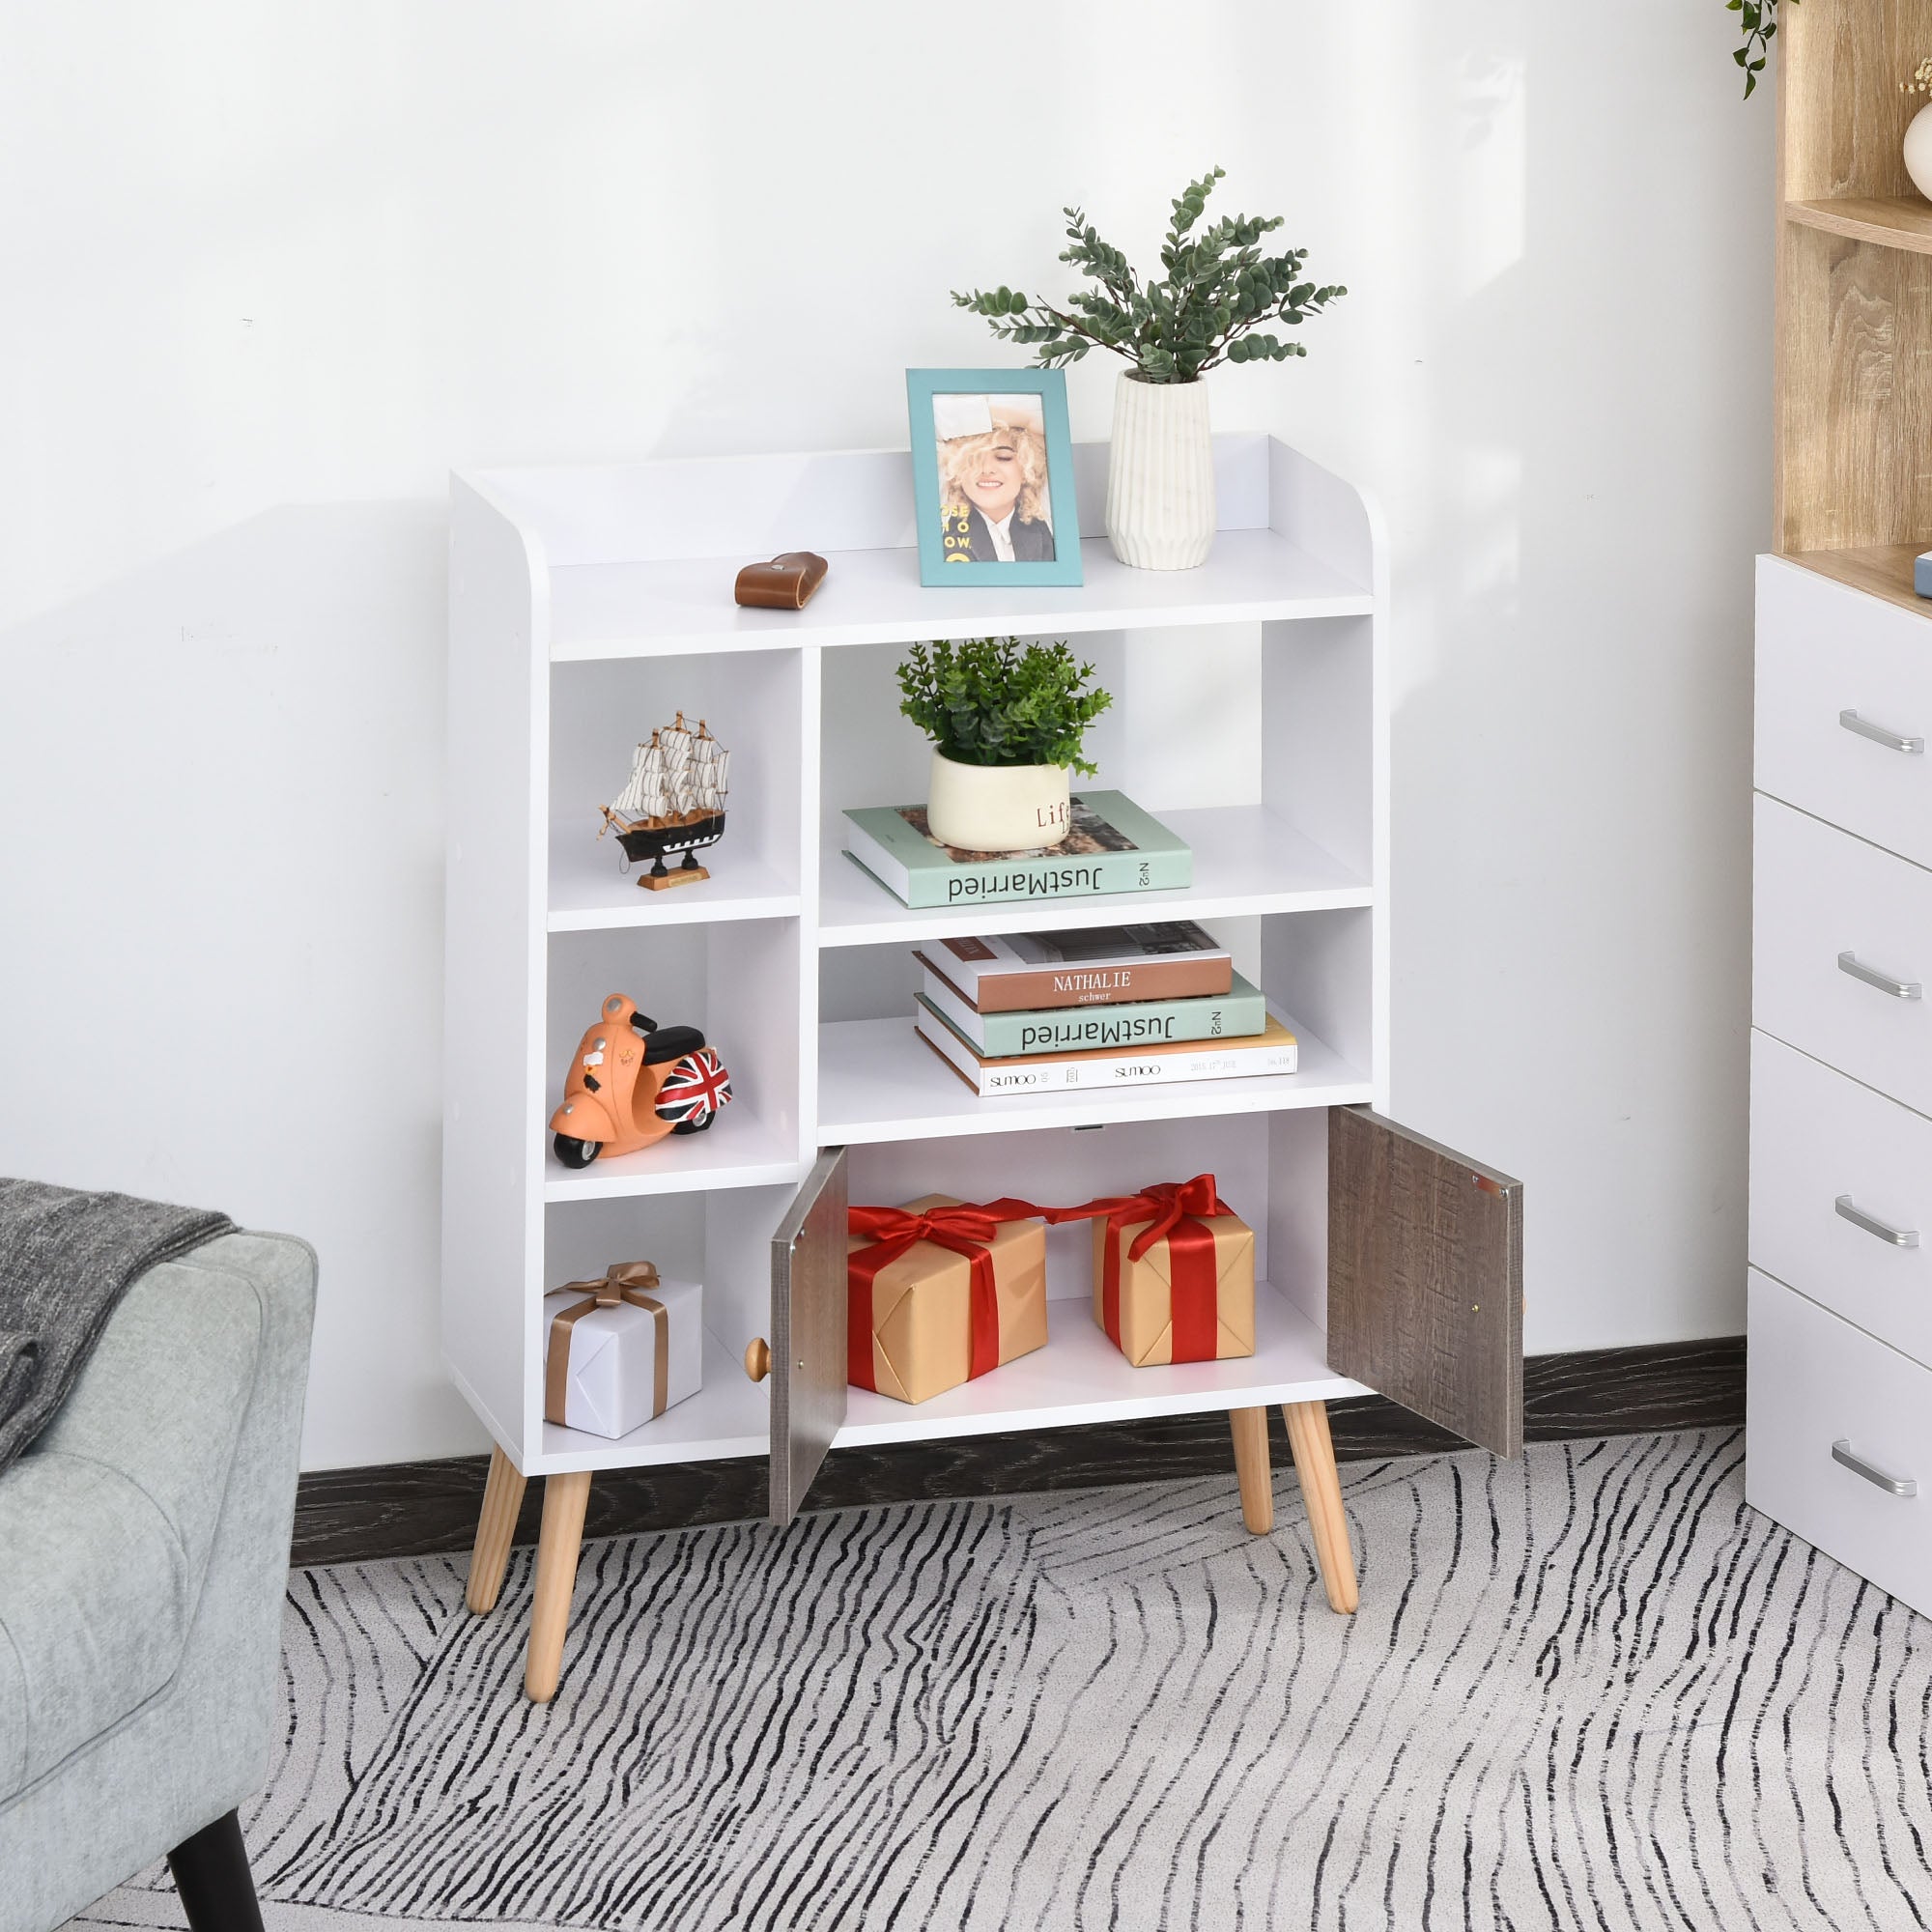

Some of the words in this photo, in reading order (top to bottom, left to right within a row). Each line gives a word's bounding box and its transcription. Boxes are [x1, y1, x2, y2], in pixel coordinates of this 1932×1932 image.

[949, 867, 1103, 902] JustMarried
[1053, 971, 1131, 992] NATHALIE
[1022, 1016, 1176, 1050] JustMarried
